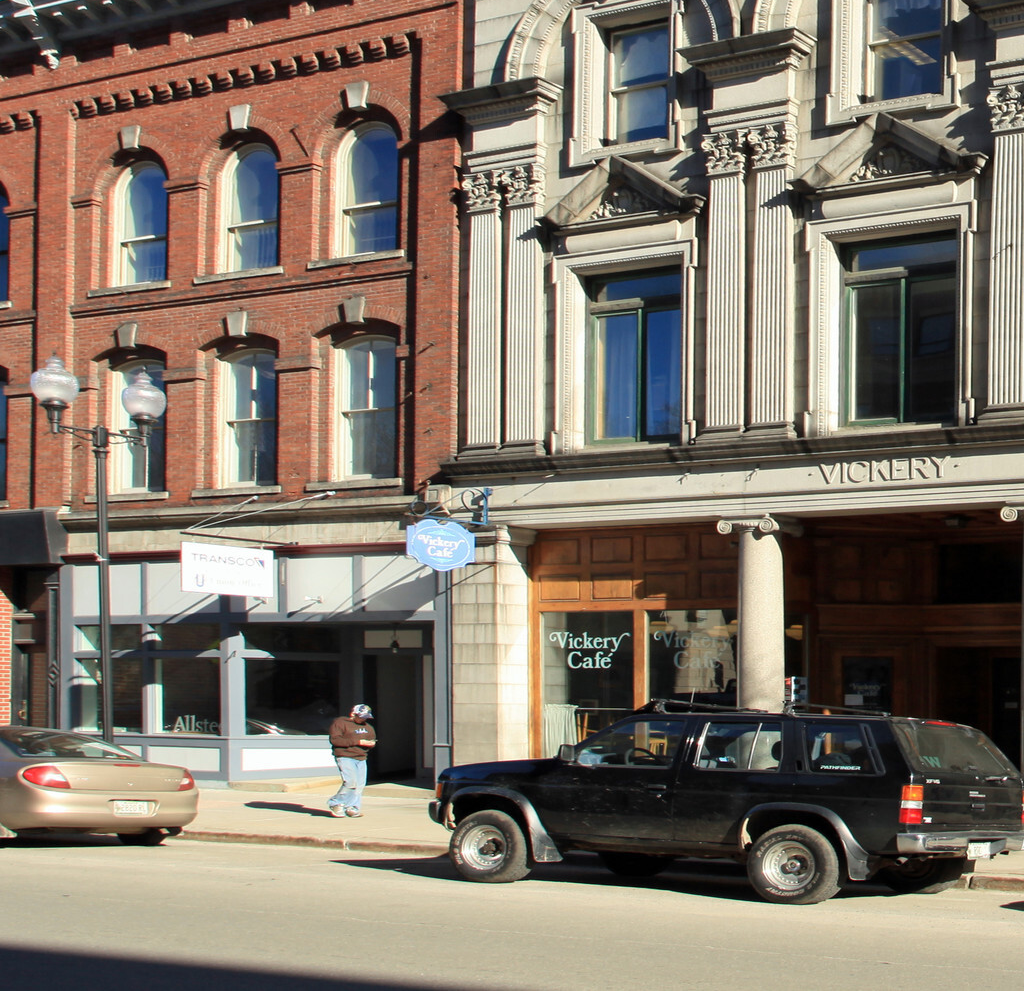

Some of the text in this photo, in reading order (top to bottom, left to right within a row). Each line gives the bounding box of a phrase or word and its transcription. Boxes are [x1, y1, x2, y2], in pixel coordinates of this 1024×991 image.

[818, 455, 952, 485] VICKERY
[417, 534, 466, 551] Vickery
[427, 545, 454, 558] Café
[549, 631, 631, 652] Vickery
[653, 631, 732, 652] Vickery
[567, 651, 614, 669] Café
[673, 651, 723, 669] Café
